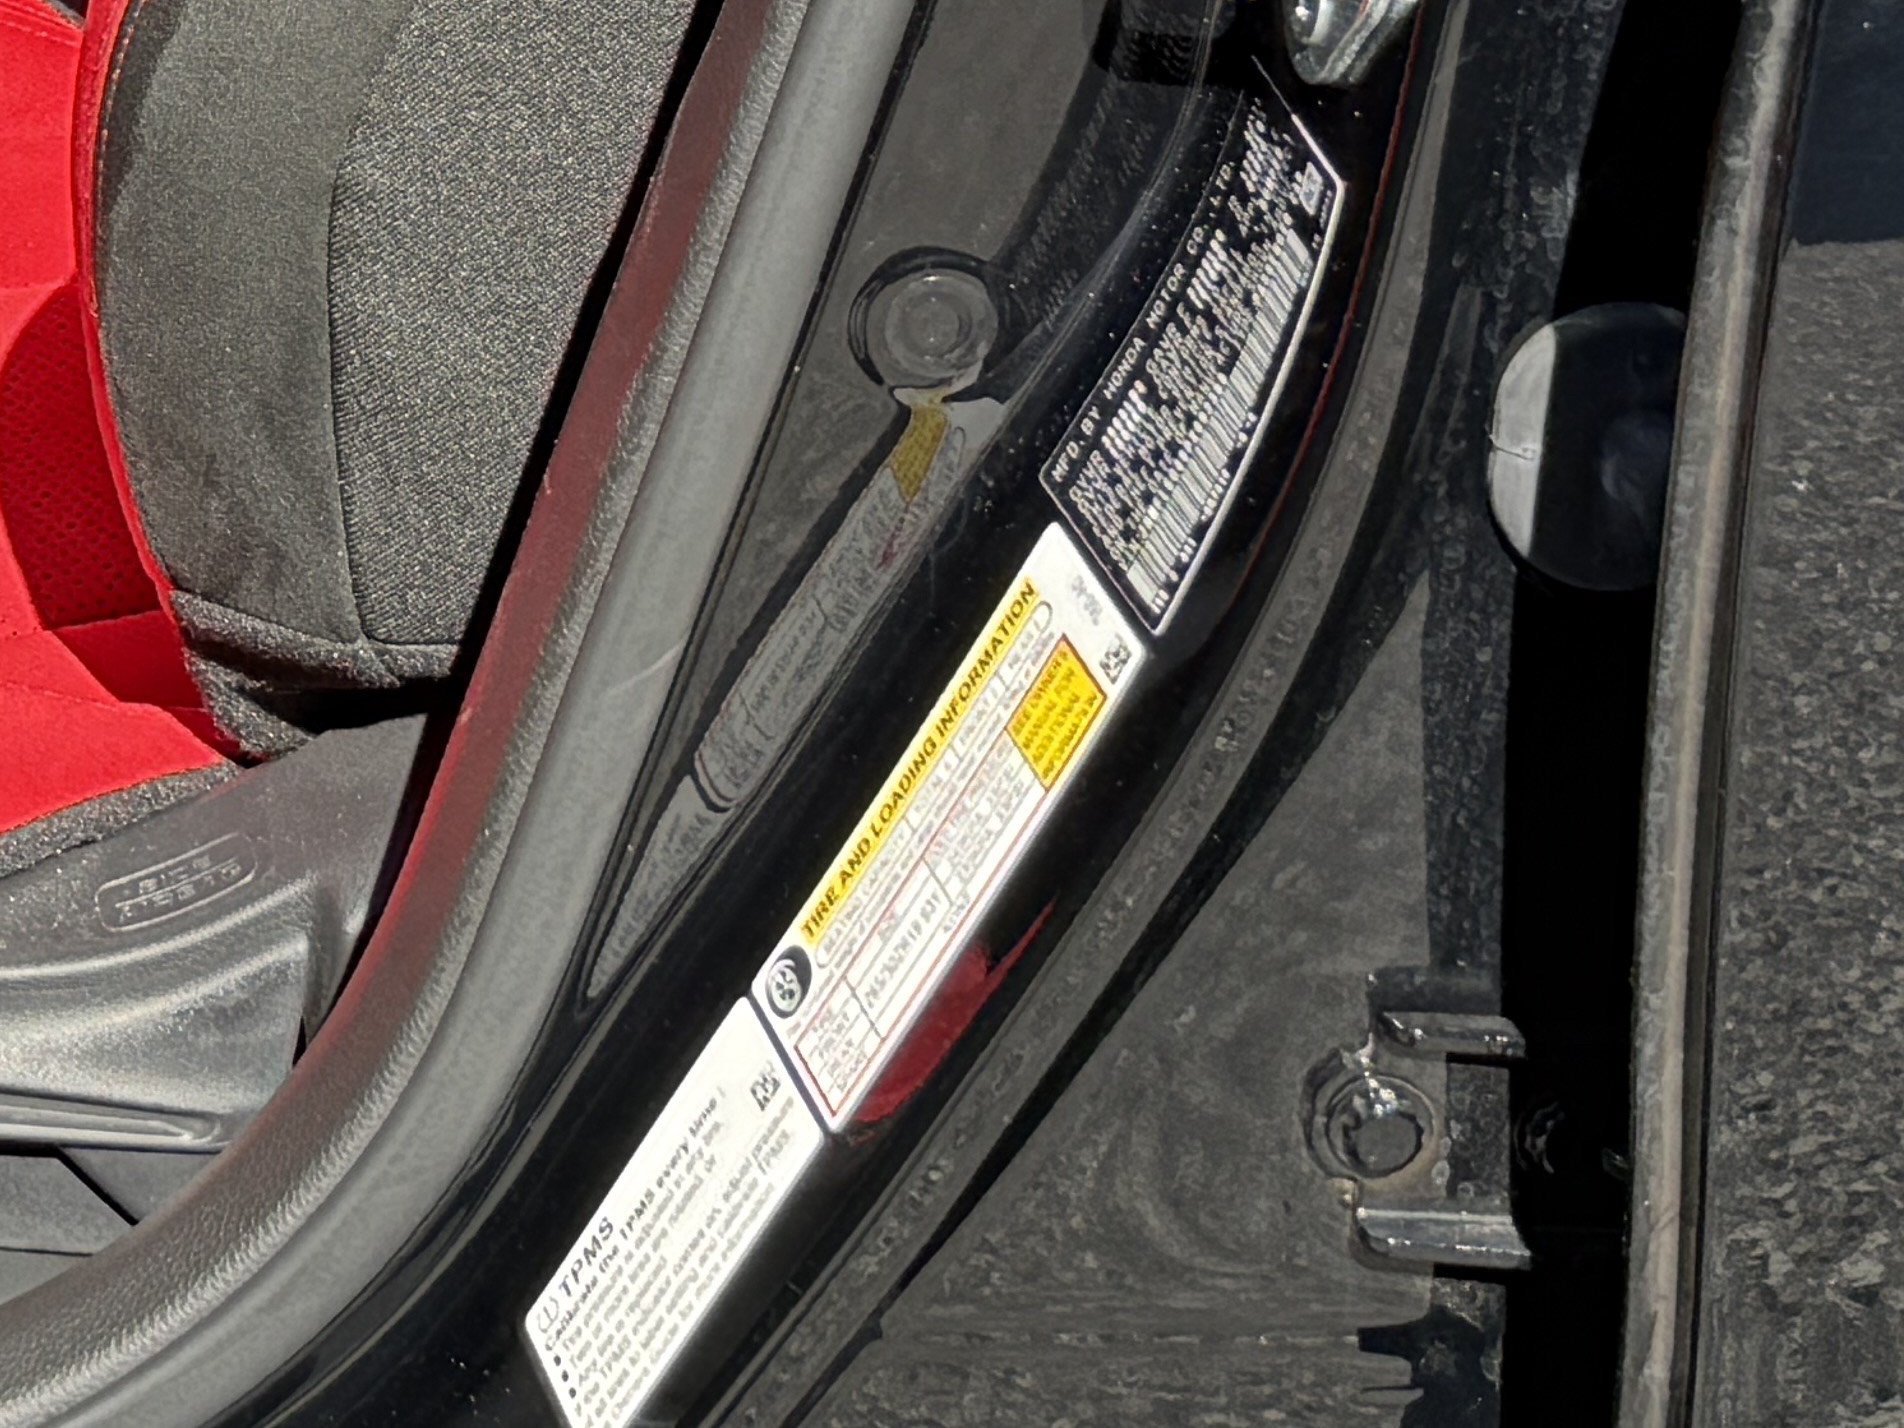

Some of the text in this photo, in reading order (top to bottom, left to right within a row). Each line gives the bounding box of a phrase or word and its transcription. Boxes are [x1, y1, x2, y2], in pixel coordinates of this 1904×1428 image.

[1101, 334, 1148, 400] HONDA
[1145, 261, 1187, 329] MOTOR
[801, 885, 840, 939] TIRE
[838, 835, 872, 887] AND
[869, 735, 938, 838] LOADING
[934, 581, 1036, 738] INFORMATION
[654, 1137, 692, 1190] every
[558, 1214, 617, 1298] TPMS
